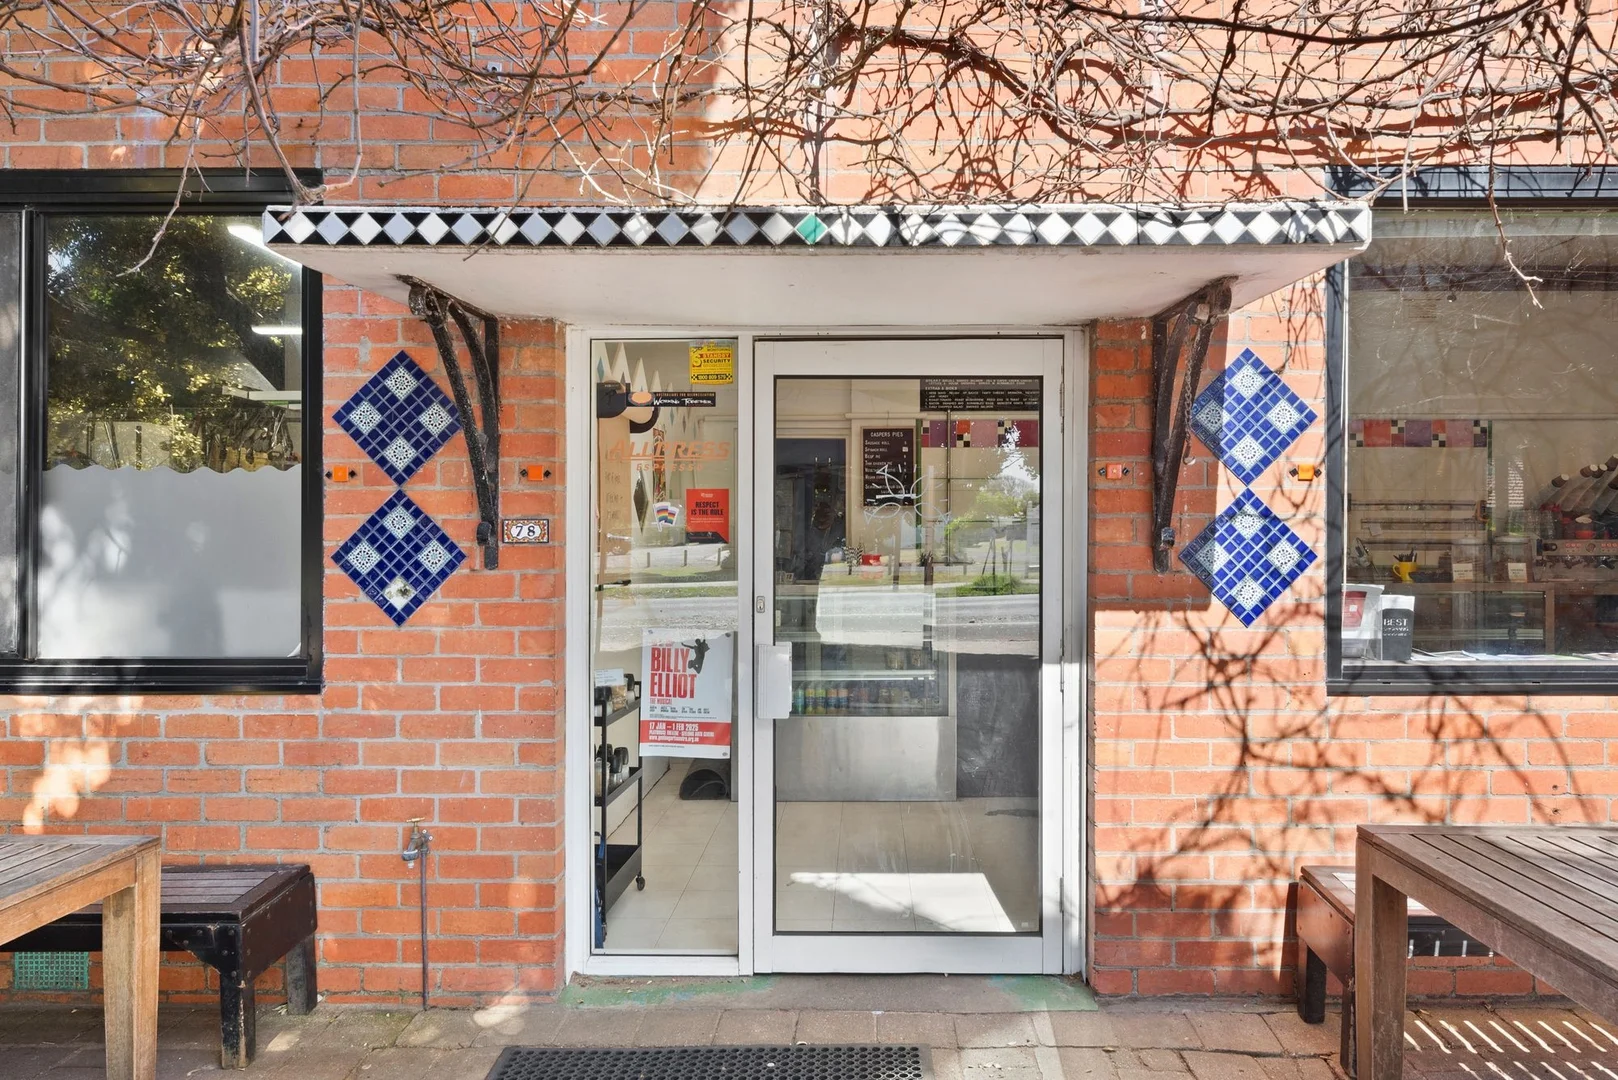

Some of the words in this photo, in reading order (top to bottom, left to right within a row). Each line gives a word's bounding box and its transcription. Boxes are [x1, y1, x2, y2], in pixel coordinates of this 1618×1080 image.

[608, 440, 731, 460] ALLPRESS
[636, 463, 704, 472] ESPRESSO
[1383, 618, 1408, 626] BEST
[651, 647, 690, 673] BILLY
[650, 672, 697, 699] ELLIOT
[649, 722, 655, 730] 17
[656, 722, 666, 730] JAN
[676, 723, 684, 731] FEB
[685, 723, 699, 731] 2025
